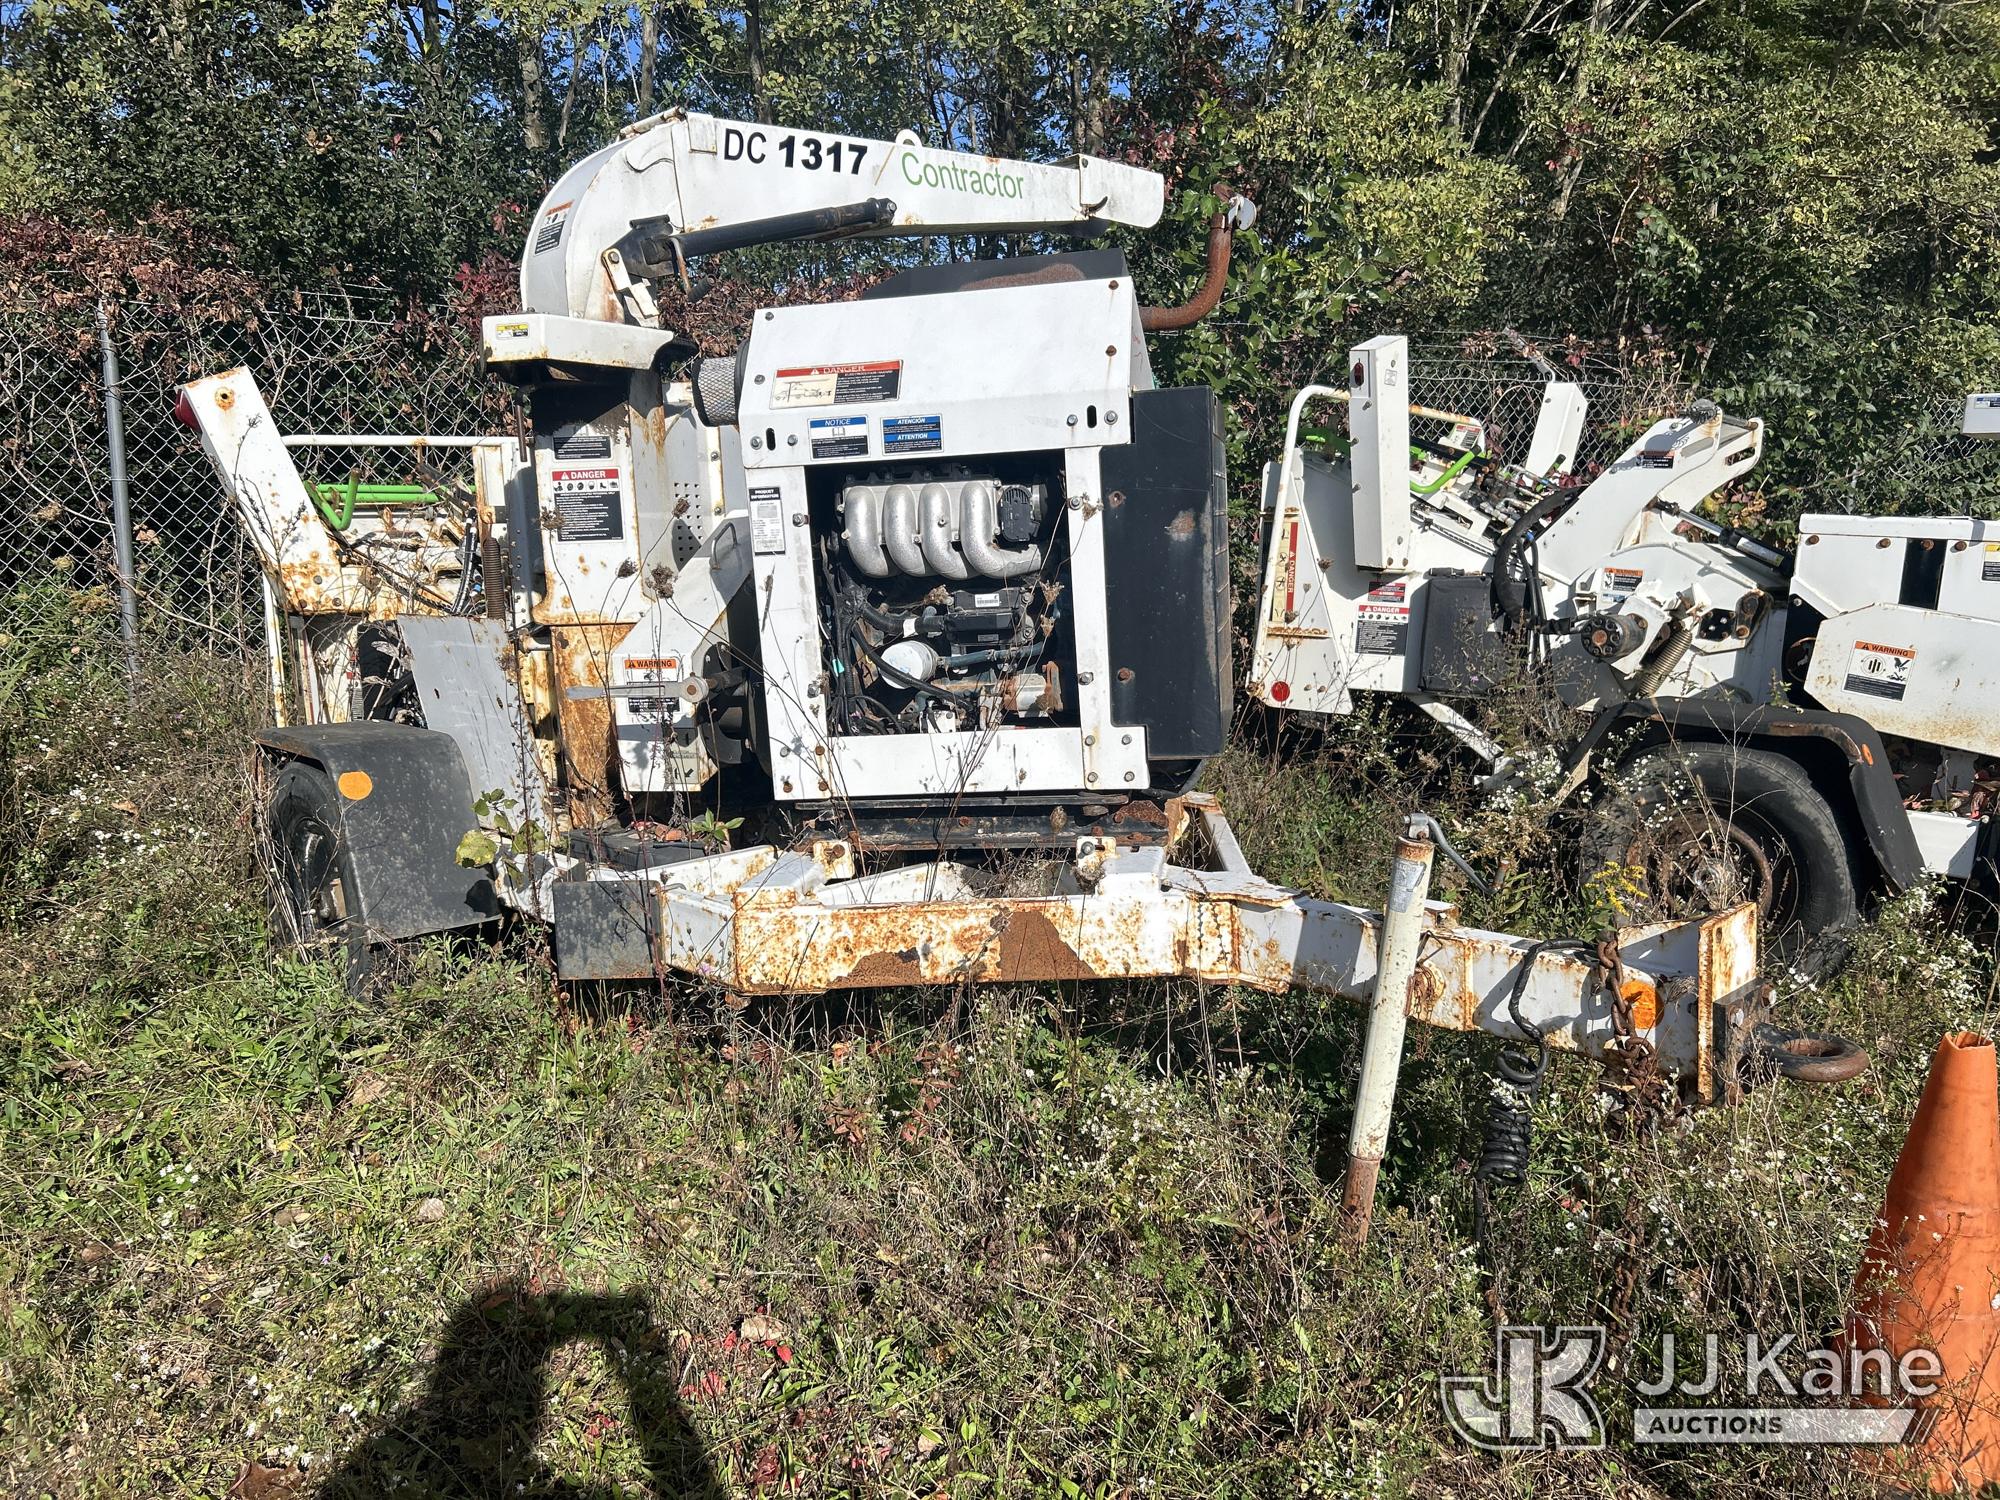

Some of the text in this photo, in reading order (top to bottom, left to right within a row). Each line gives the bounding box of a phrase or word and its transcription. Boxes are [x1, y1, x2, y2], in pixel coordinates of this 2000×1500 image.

[724, 128, 868, 175] DC 1317
[901, 152, 1024, 199] Contractor
[823, 366, 865, 374] DANGER
[825, 418, 851, 426] NOTICE
[897, 432, 928, 440] ATTENTION
[571, 471, 606, 479] DANGER
[1287, 561, 1296, 593] DANGER
[1872, 643, 1909, 657] WARNING
